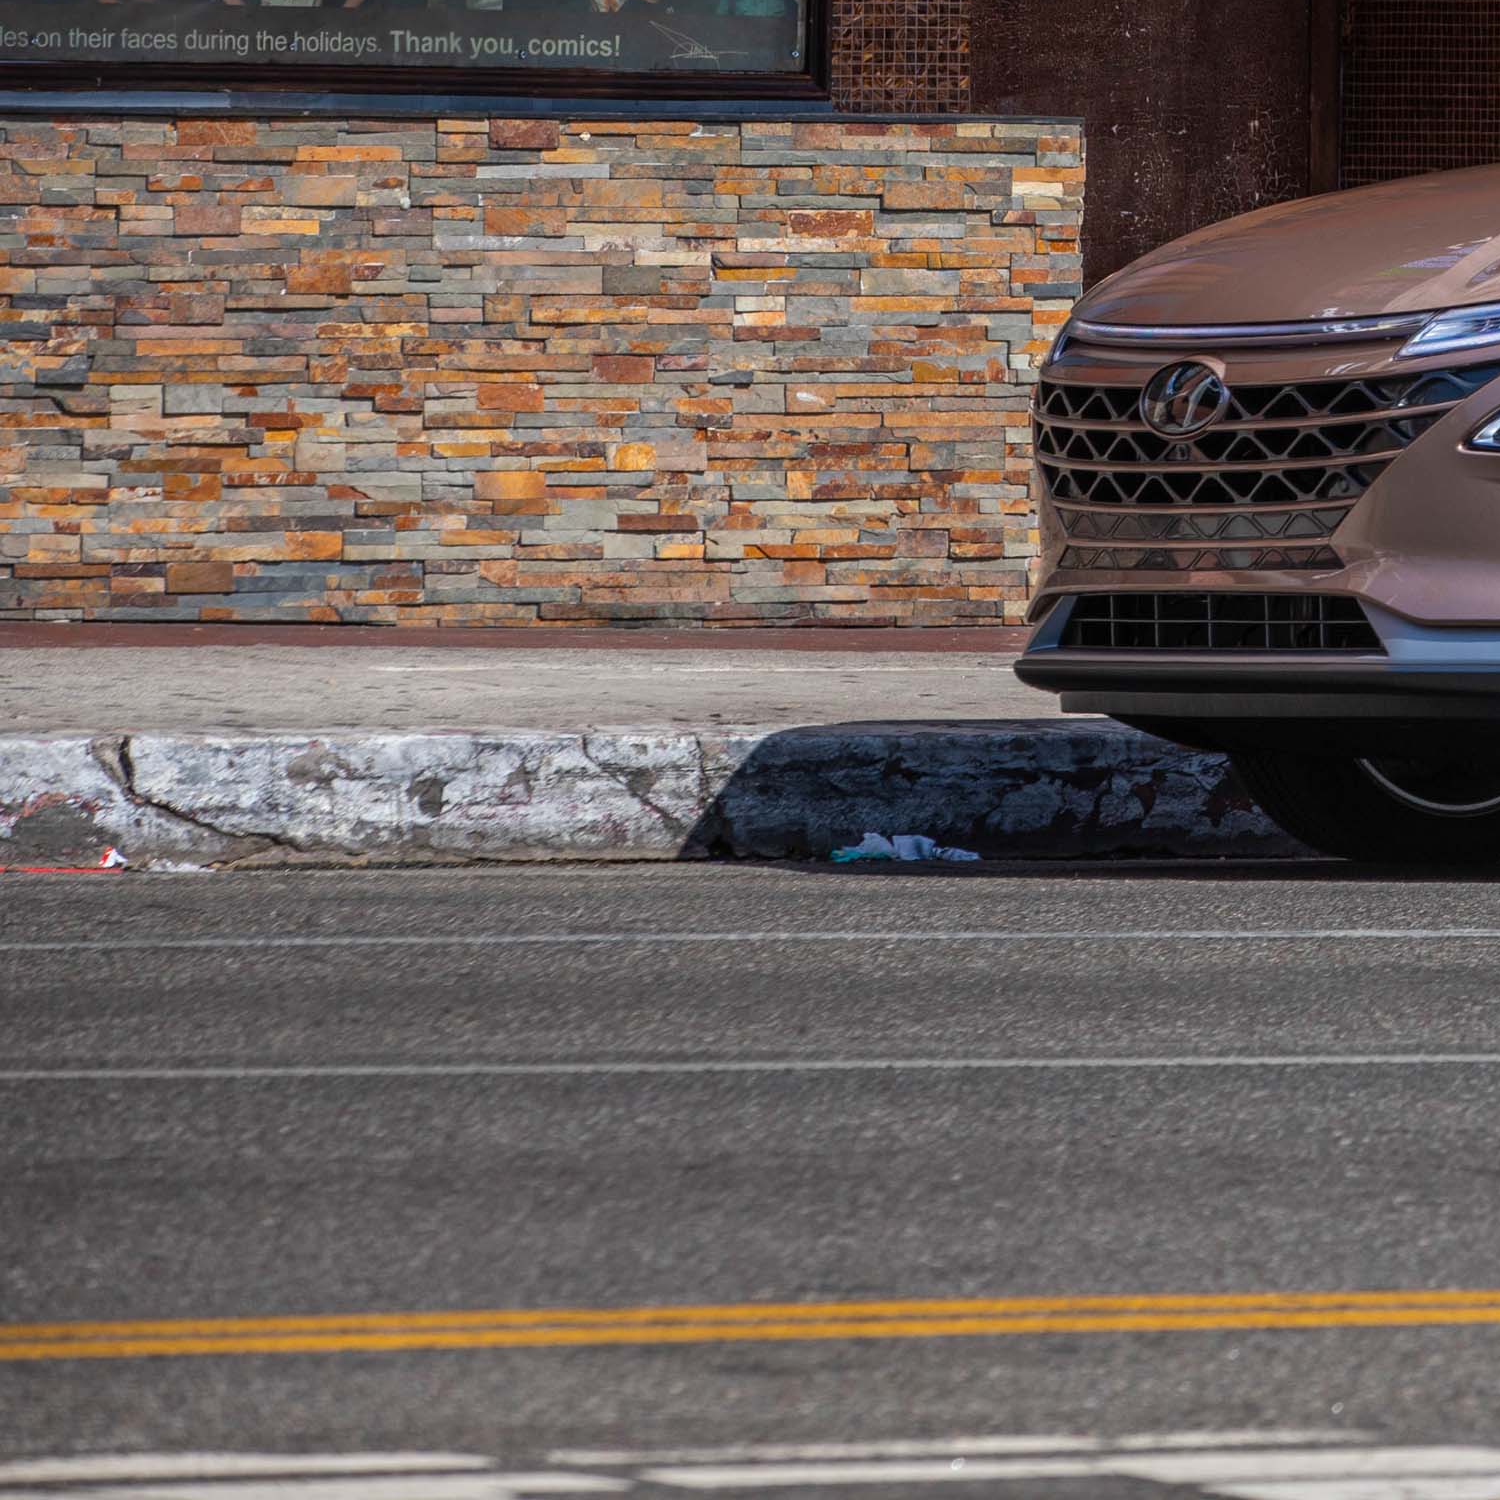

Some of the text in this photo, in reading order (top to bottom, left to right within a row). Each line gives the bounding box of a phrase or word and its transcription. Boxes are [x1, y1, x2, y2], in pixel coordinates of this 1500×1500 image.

[37, 31, 61, 48] on
[69, 28, 115, 49] their
[120, 28, 177, 49] faces
[184, 29, 249, 55] during
[256, 31, 286, 50] the
[293, 31, 382, 56] holidays.
[390, 30, 462, 54] Thank
[528, 34, 621, 57] comics!
